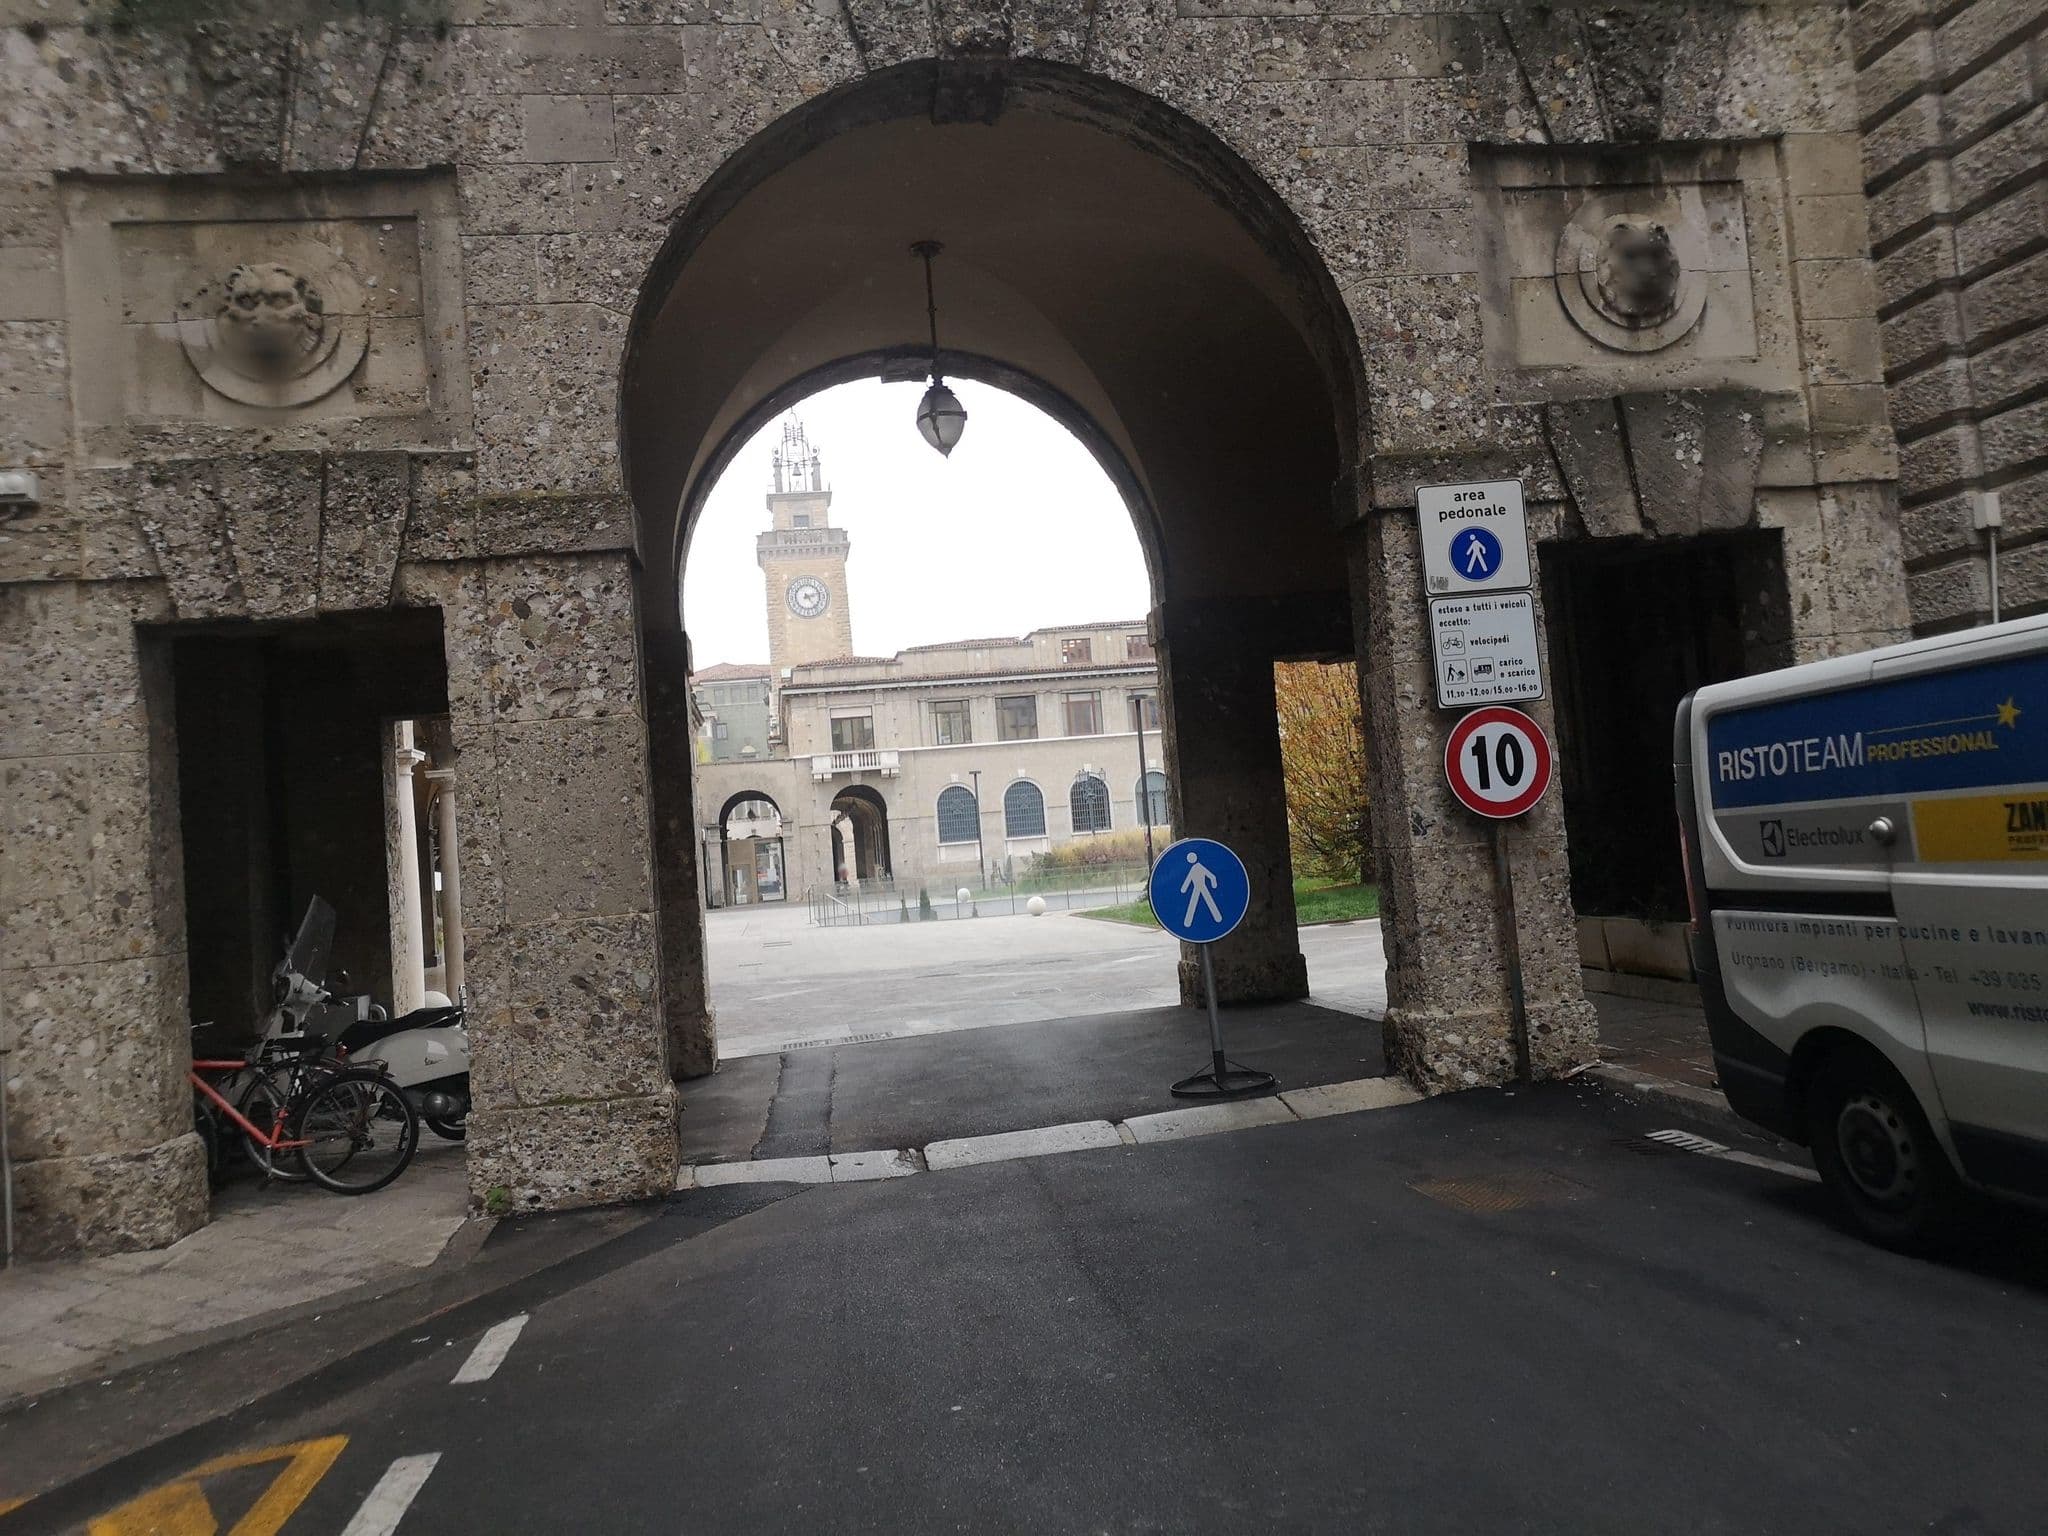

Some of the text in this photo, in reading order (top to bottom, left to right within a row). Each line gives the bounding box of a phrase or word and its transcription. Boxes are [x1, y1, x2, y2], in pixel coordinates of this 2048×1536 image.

[1454, 491, 1486, 502] area
[1439, 504, 1507, 523] pedonale
[1438, 606, 1463, 614] esteso
[1473, 602, 1492, 611] tutti
[1500, 600, 1526, 609] veicoli
[1439, 618, 1471, 627] eccetto:
[1470, 634, 1510, 646] velocipedi
[1499, 658, 1523, 667] carico
[1508, 668, 1536, 677] scarico
[1471, 732, 1524, 790] 10
[1718, 732, 1864, 782] RISTOTEAM
[1787, 825, 1865, 848] Electrolux
[1864, 925, 1891, 941] per
[1898, 924, 1961, 942] cucine
[1969, 928, 1980, 942] e
[1731, 951, 1785, 970] Urgnano
[1791, 955, 1866, 977] (Bergamo)
